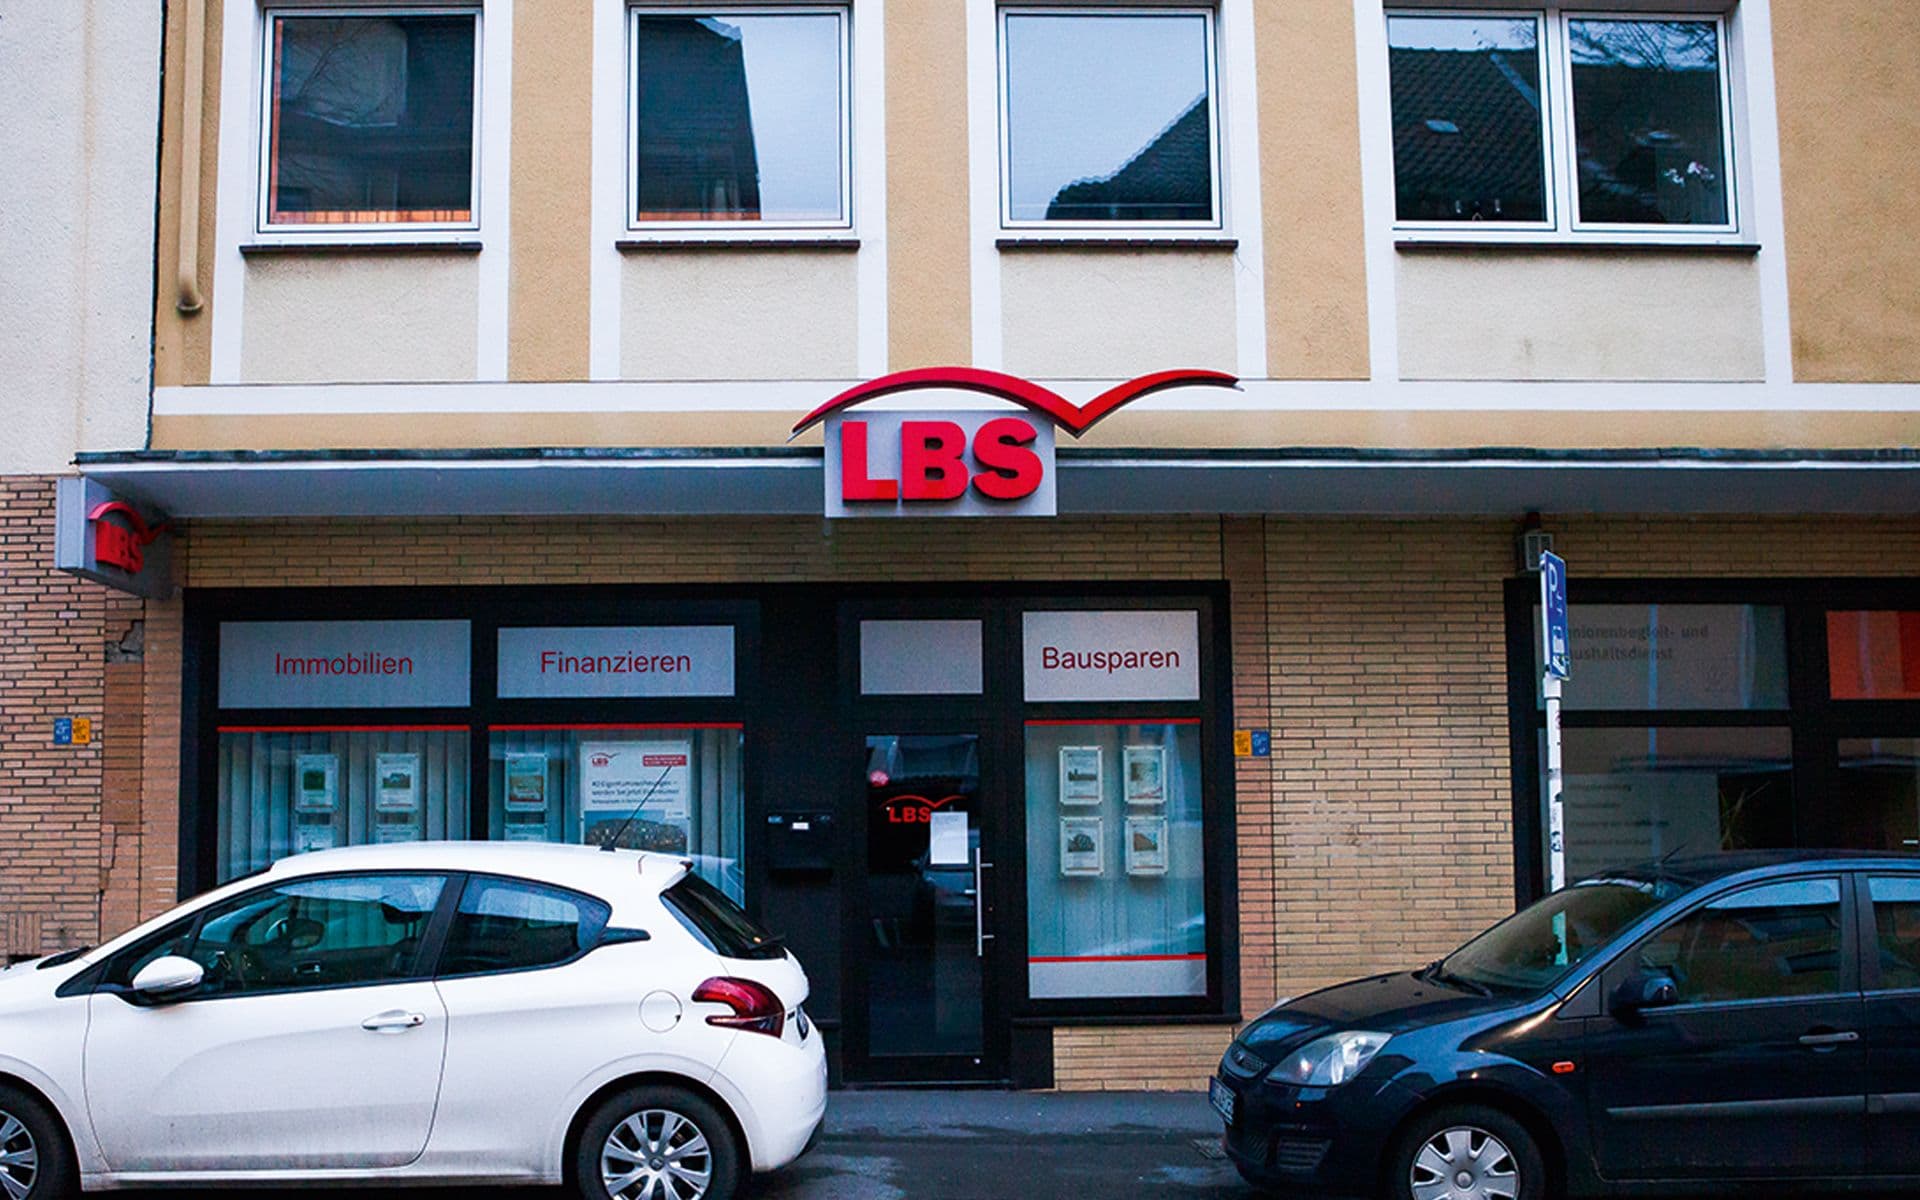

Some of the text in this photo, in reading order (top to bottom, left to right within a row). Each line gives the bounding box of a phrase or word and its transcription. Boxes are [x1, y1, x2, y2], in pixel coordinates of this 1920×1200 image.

[841, 418, 1044, 501] LBS
[1548, 562, 1558, 609] P
[1681, 623, 1709, 638] und
[276, 653, 414, 675] Immobilien
[541, 651, 691, 673] Finanzieren
[1043, 647, 1180, 673] Bausparen
[888, 807, 931, 823] LBS
